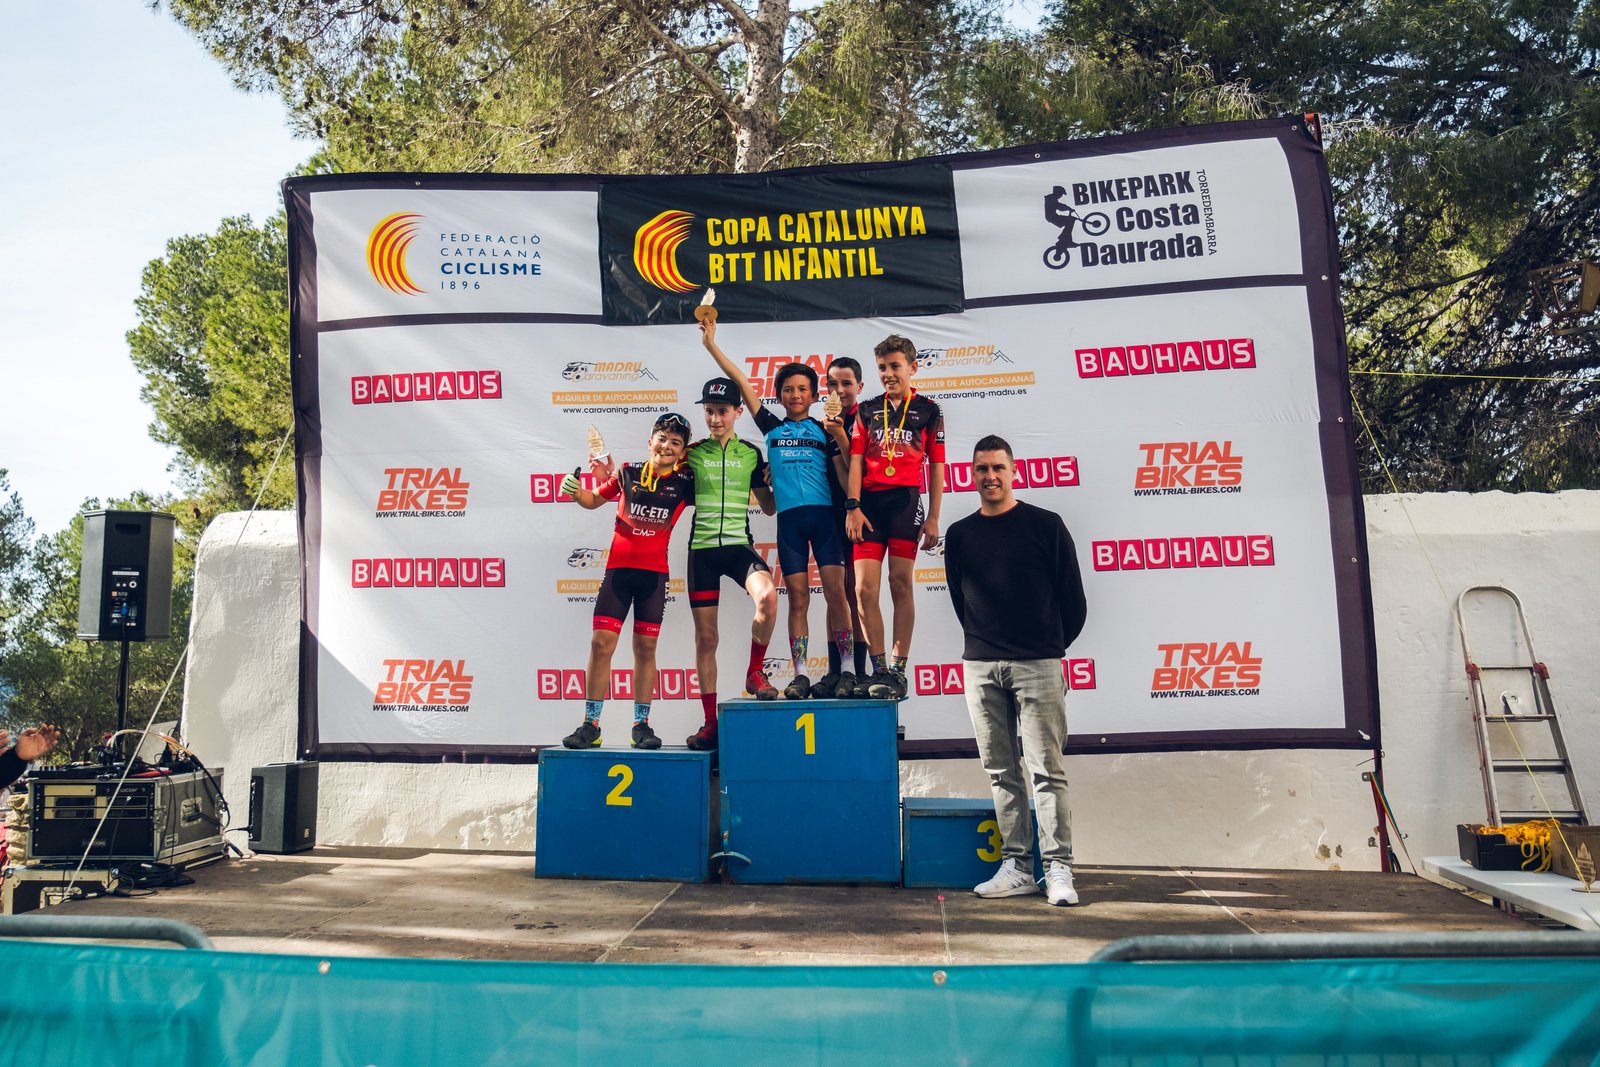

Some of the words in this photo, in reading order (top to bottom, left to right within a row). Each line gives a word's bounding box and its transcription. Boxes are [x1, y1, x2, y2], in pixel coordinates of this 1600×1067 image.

[1072, 170, 1195, 206] BIKEPARK
[1116, 203, 1200, 232] Costa
[1196, 169, 1217, 256] TORREDEMBARRA
[706, 216, 772, 247] COPA
[778, 206, 927, 244] CATALUNYA
[440, 233, 541, 245] FEDERACIÓ
[1080, 233, 1204, 267] Daurada
[440, 247, 541, 259] CATALANA
[440, 262, 542, 275] CICLISME
[709, 252, 756, 284] BTT
[763, 247, 884, 282] INFANTIL
[441, 280, 480, 290] 1896
[945, 344, 995, 358] MADRU
[1079, 342, 1251, 373] BAUHAUS
[594, 361, 642, 372] MADRU
[355, 374, 498, 400] BAUHAUS
[946, 378, 958, 387] DE
[960, 373, 1035, 387] AUTOCARAVANAS
[556, 394, 591, 402] ALQUILER
[593, 393, 603, 402] DE
[605, 392, 678, 402] AUTOCARAVANAS
[563, 406, 669, 415] www.caravaning-madru.es
[1139, 441, 1243, 466] TRIAL
[384, 467, 470, 489] TRIAL
[1135, 464, 1243, 488] BIKES
[377, 489, 469, 511] BIKES
[1134, 486, 1242, 496] WWW.TRIAL-BIKES.COM
[375, 510, 466, 518] WWW.TRIAL-BIKES.COM
[630, 502, 669, 519] VIC-ETB
[1096, 539, 1270, 566] BAUHAUS
[355, 561, 501, 584] BAUHAUS
[560, 582, 597, 590] ALQUILER
[1157, 641, 1263, 667] TRIAL
[383, 659, 474, 682] TRIAL
[1151, 665, 1262, 691] BIKES
[374, 682, 473, 705] BIKES
[541, 673, 701, 695] BAHUS
[1151, 688, 1260, 698] WWW.TRIAL-BIKES.COM
[373, 704, 469, 712] WWW.TRIAL-BIKES.COM
[795, 712, 816, 755] 1
[606, 763, 634, 807] 2
[976, 819, 1004, 863] 3
